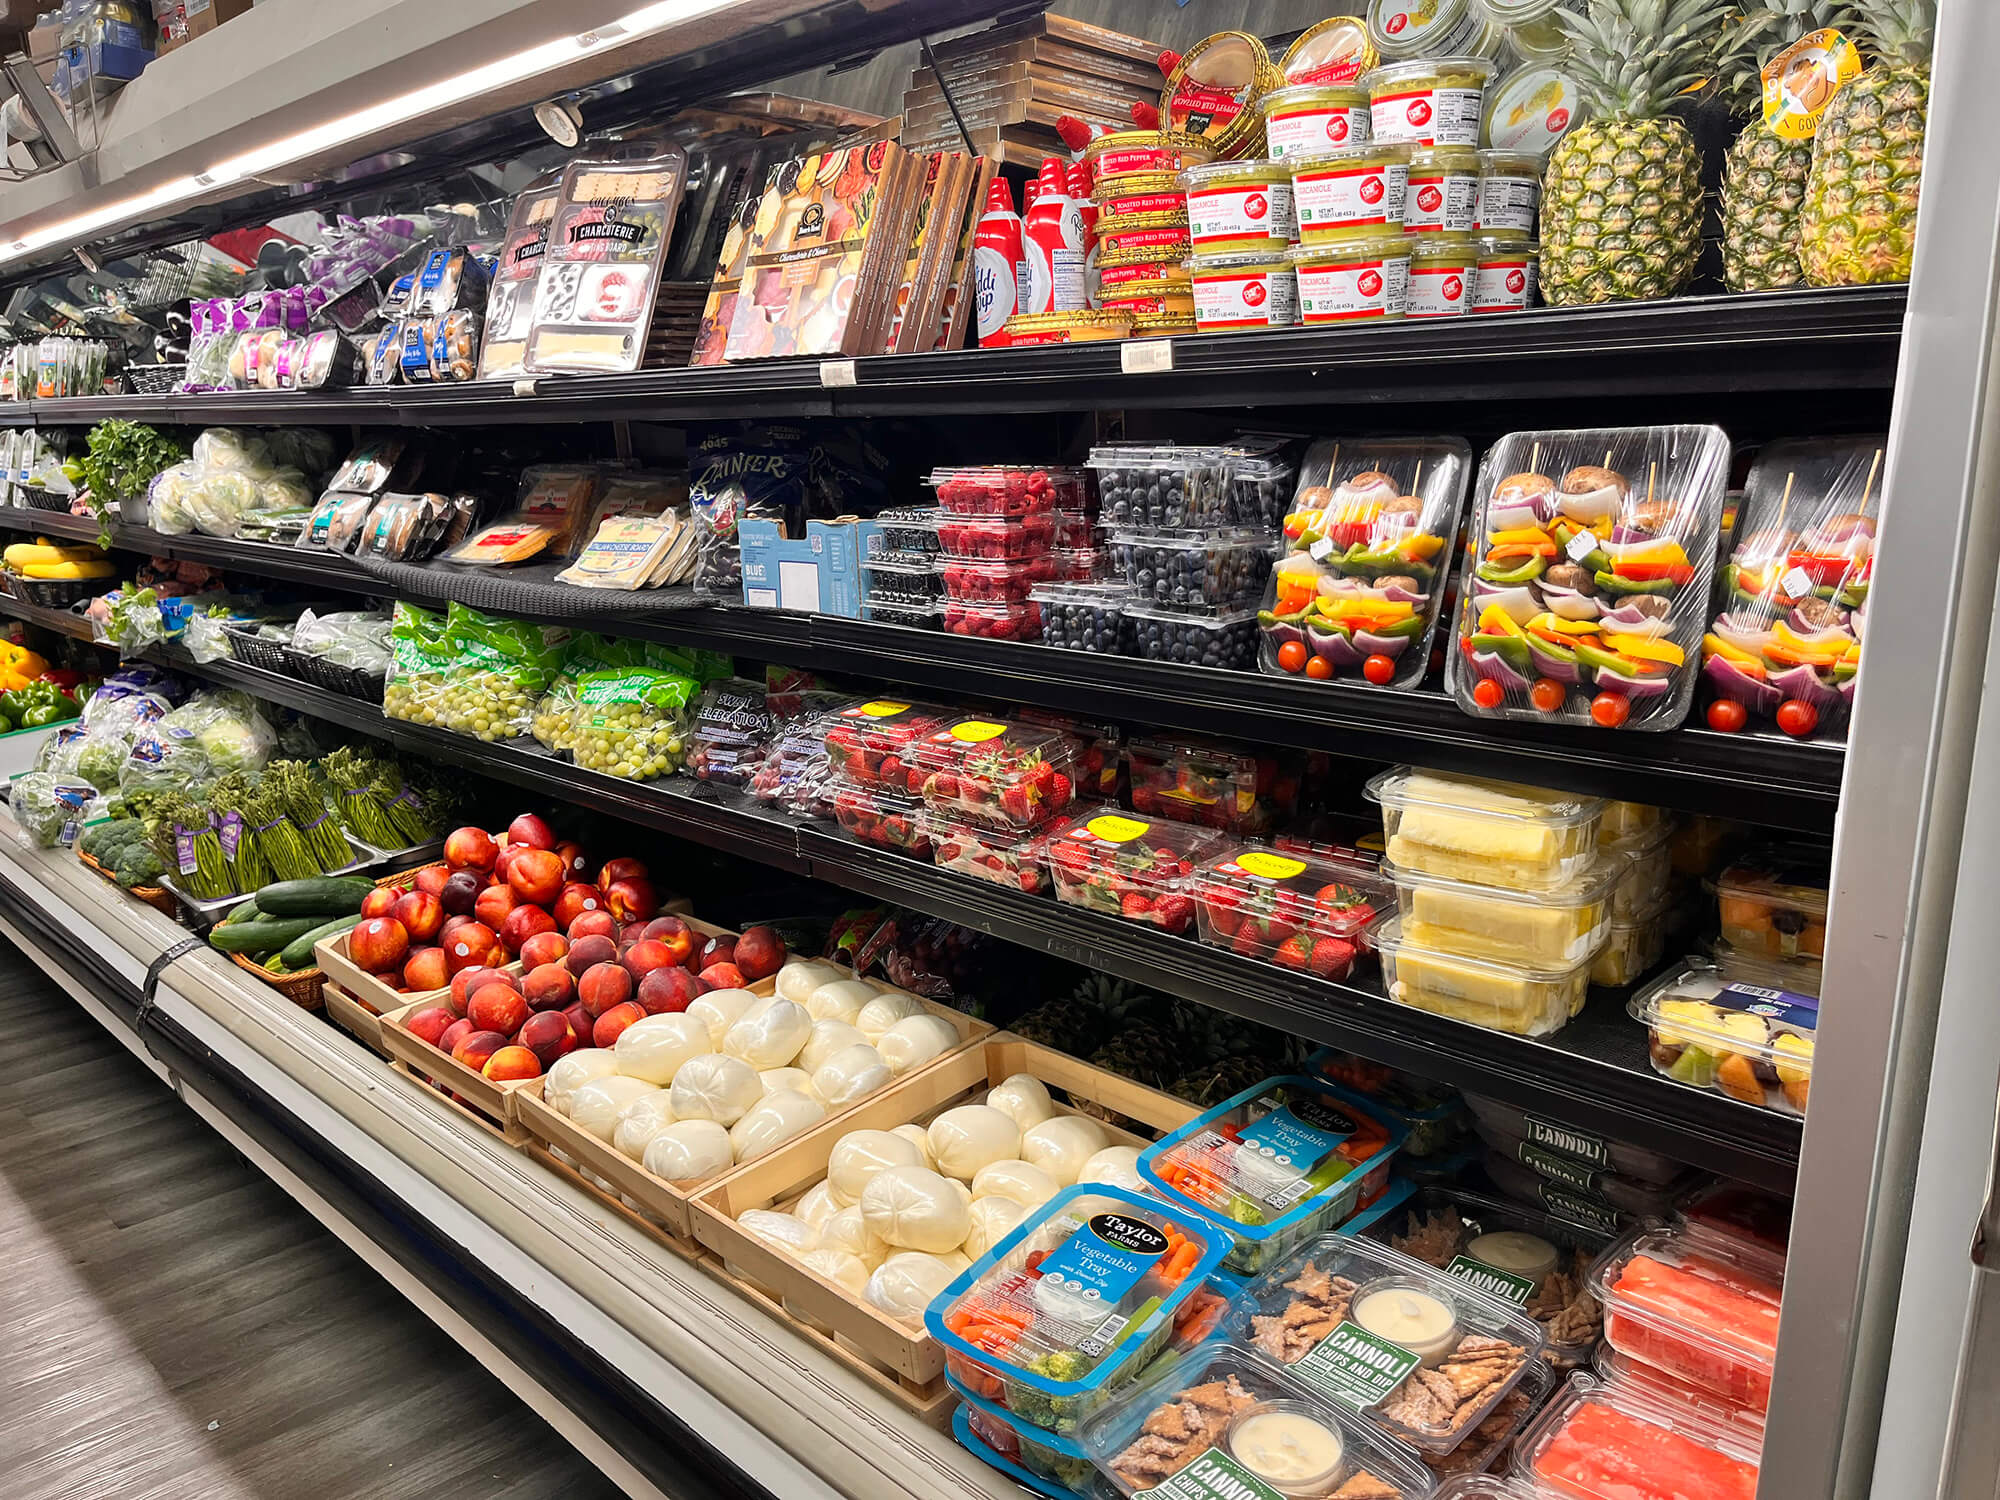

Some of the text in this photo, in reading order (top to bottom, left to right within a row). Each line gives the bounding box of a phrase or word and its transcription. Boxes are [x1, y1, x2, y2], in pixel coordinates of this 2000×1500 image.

[1117, 200, 1141, 209] ROASTED
[1155, 198, 1176, 206] PEPPER
[580, 225, 636, 239] CHARCUTERIE
[1120, 235, 1144, 244] ROASTED
[1158, 232, 1180, 240] PEPPER
[521, 240, 547, 258] CHARCUT
[699, 437, 729, 451] 4045
[689, 452, 788, 499] RAINIER
[745, 564, 764, 577] BLUE
[1302, 1101, 1353, 1129] Taylor
[1271, 1116, 1327, 1149] Vegetable
[1275, 1129, 1303, 1149] Tray
[1535, 1124, 1601, 1160] CANNOLI
[1103, 1215, 1163, 1246] Taylor
[1106, 1231, 1141, 1248] FARMS
[1073, 1239, 1138, 1274] Vegetable
[1079, 1256, 1112, 1277] Tray
[1450, 1263, 1525, 1301] CANNOLI
[1317, 1345, 1351, 1368] CHIPS
[1347, 1362, 1374, 1380] AND
[1371, 1373, 1395, 1389] DIP
[1328, 1331, 1409, 1378] CANNOLI
[1174, 1474, 1208, 1500] CHIPS
